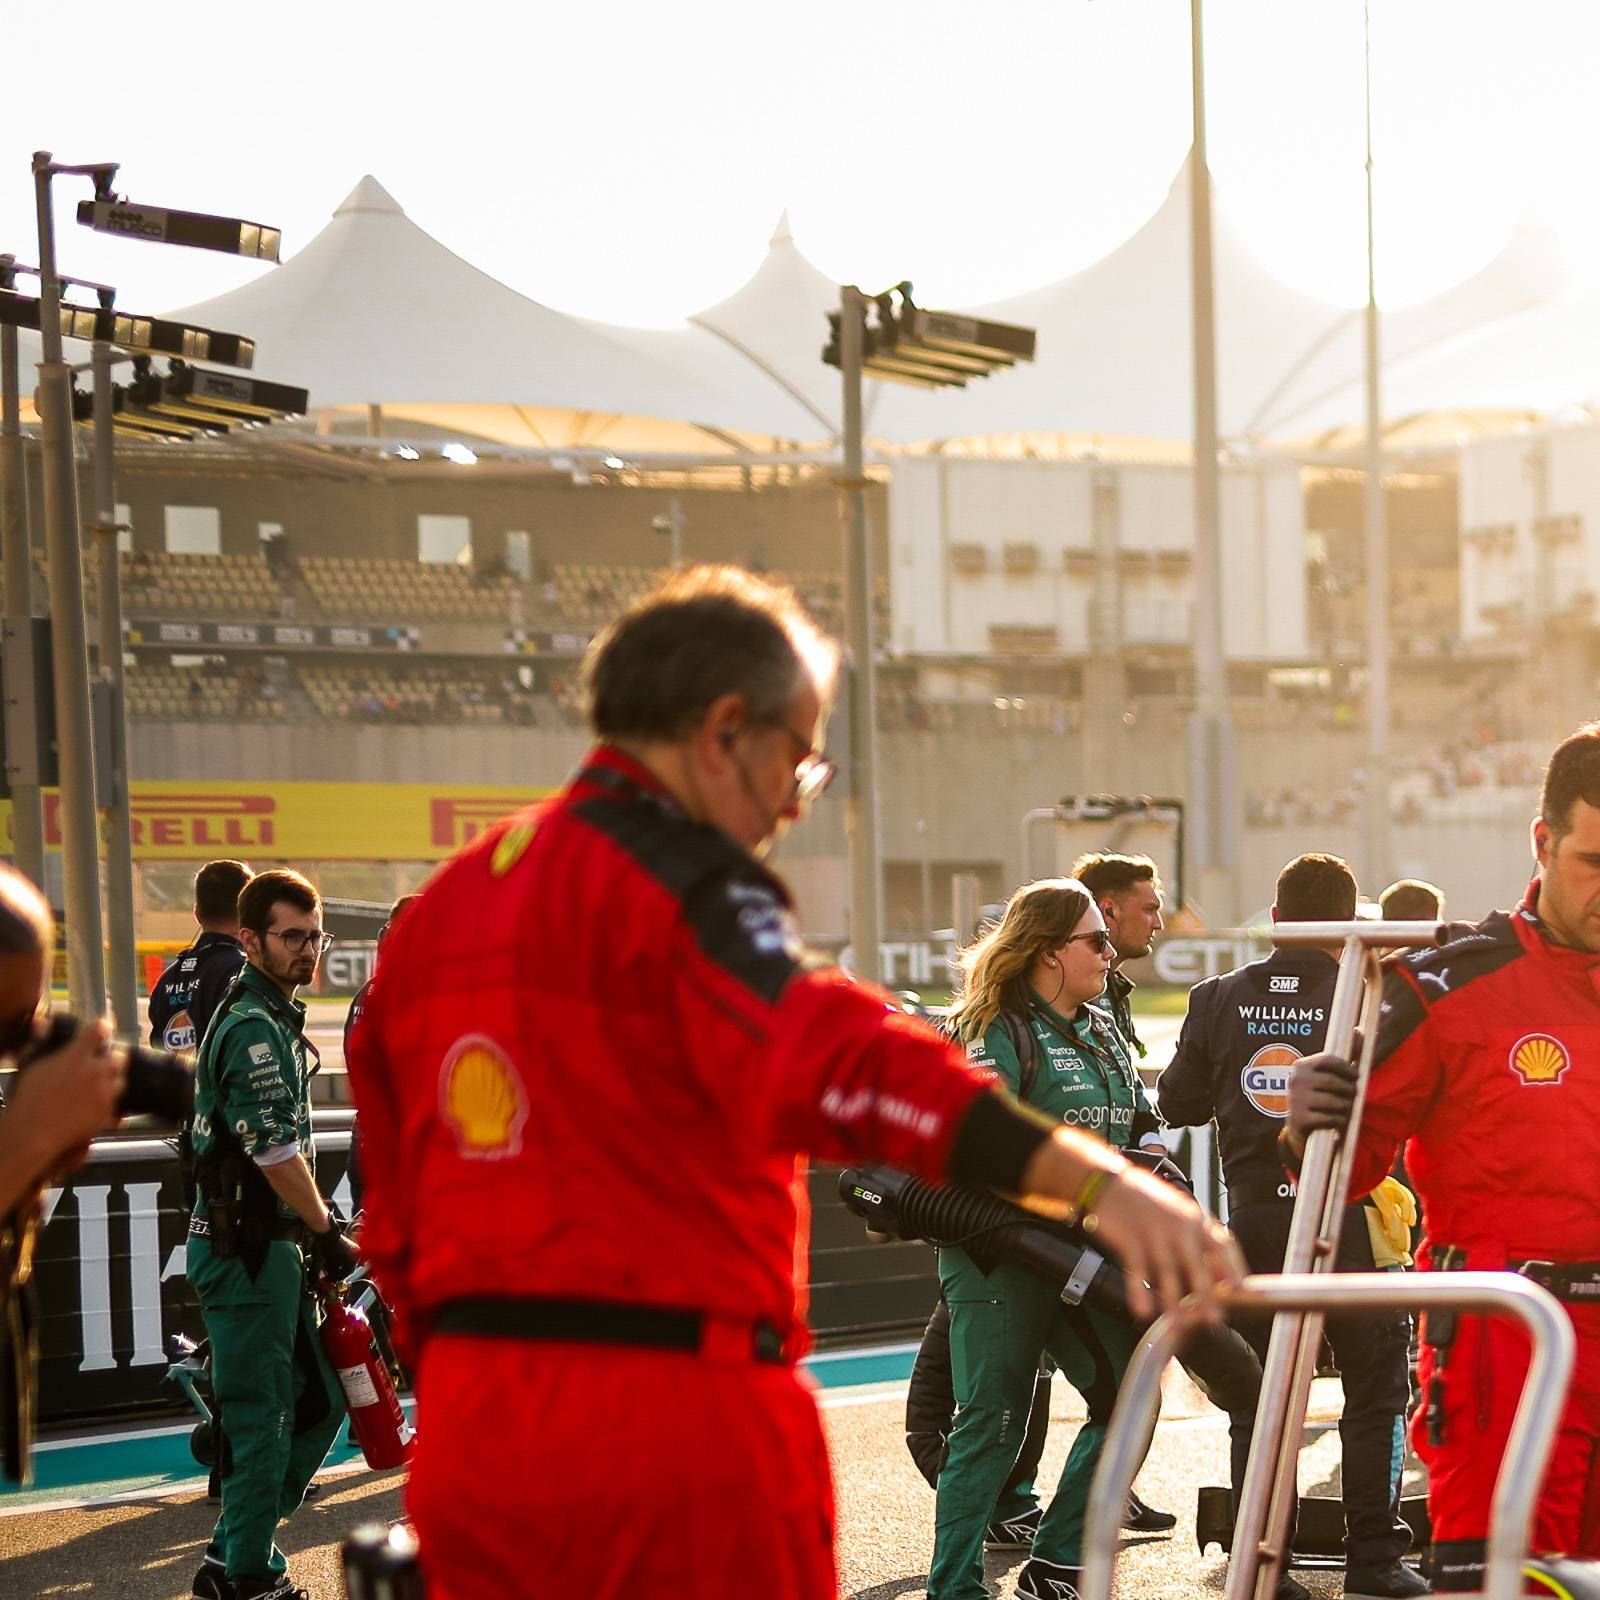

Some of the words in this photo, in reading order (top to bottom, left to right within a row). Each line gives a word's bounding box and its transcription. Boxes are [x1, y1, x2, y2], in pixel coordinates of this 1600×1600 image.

[1269, 978, 1299, 991] OMP
[1238, 1005, 1325, 1022] WILLIAMS
[1247, 1022, 1313, 1037] RACING
[853, 1187, 882, 1204] EGO
